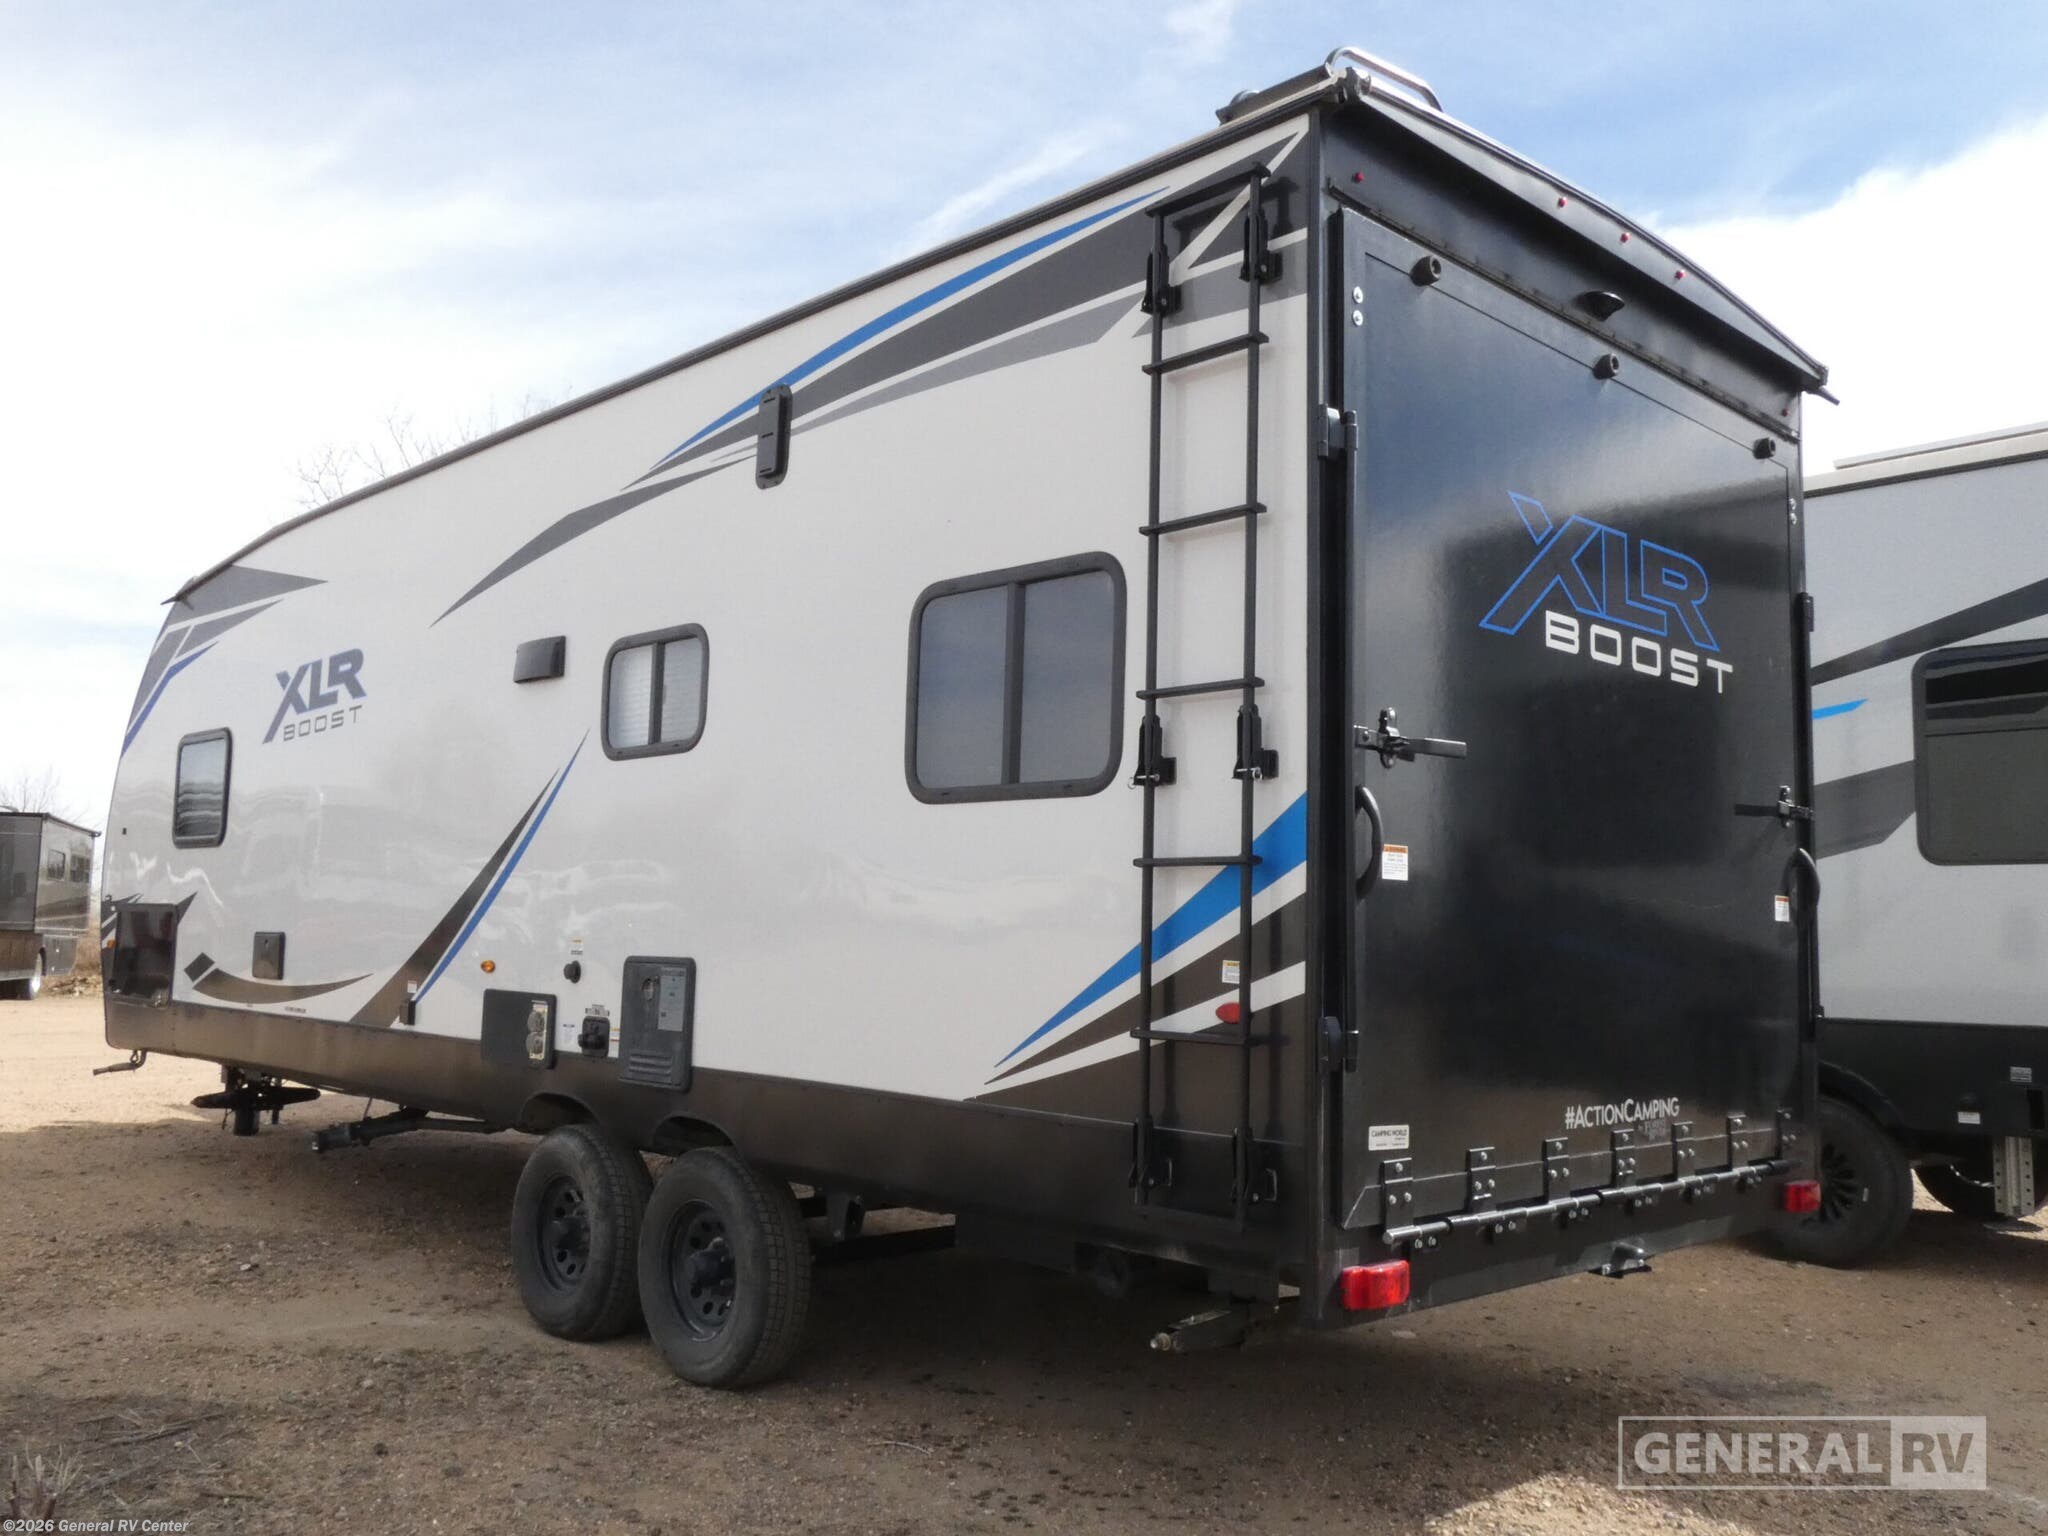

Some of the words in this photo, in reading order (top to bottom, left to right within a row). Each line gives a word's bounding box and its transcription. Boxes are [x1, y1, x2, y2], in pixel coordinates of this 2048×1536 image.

[1479, 490, 1720, 651] XLR
[262, 648, 367, 744] XLR
[1545, 610, 1734, 694] BOOST
[283, 704, 363, 742] BOOST
